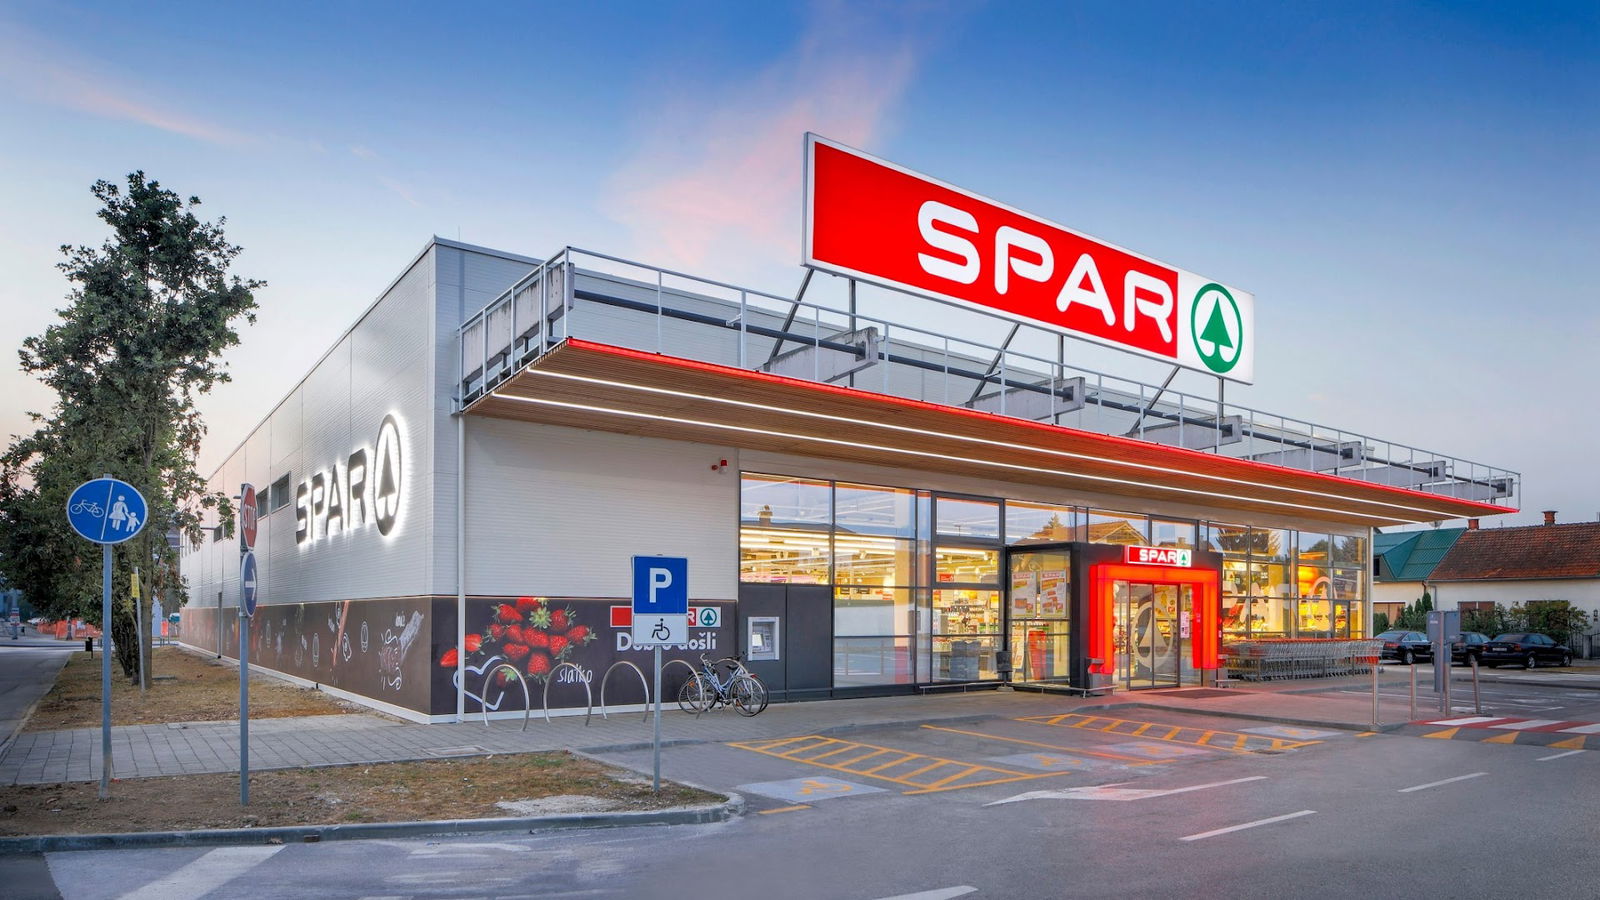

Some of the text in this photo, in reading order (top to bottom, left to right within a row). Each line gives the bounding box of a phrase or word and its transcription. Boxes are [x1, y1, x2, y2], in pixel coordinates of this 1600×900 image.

[917, 200, 1175, 344] SPAR
[295, 448, 367, 545] SPAR
[649, 567, 673, 603] P
[1139, 549, 1177, 563] SPAR
